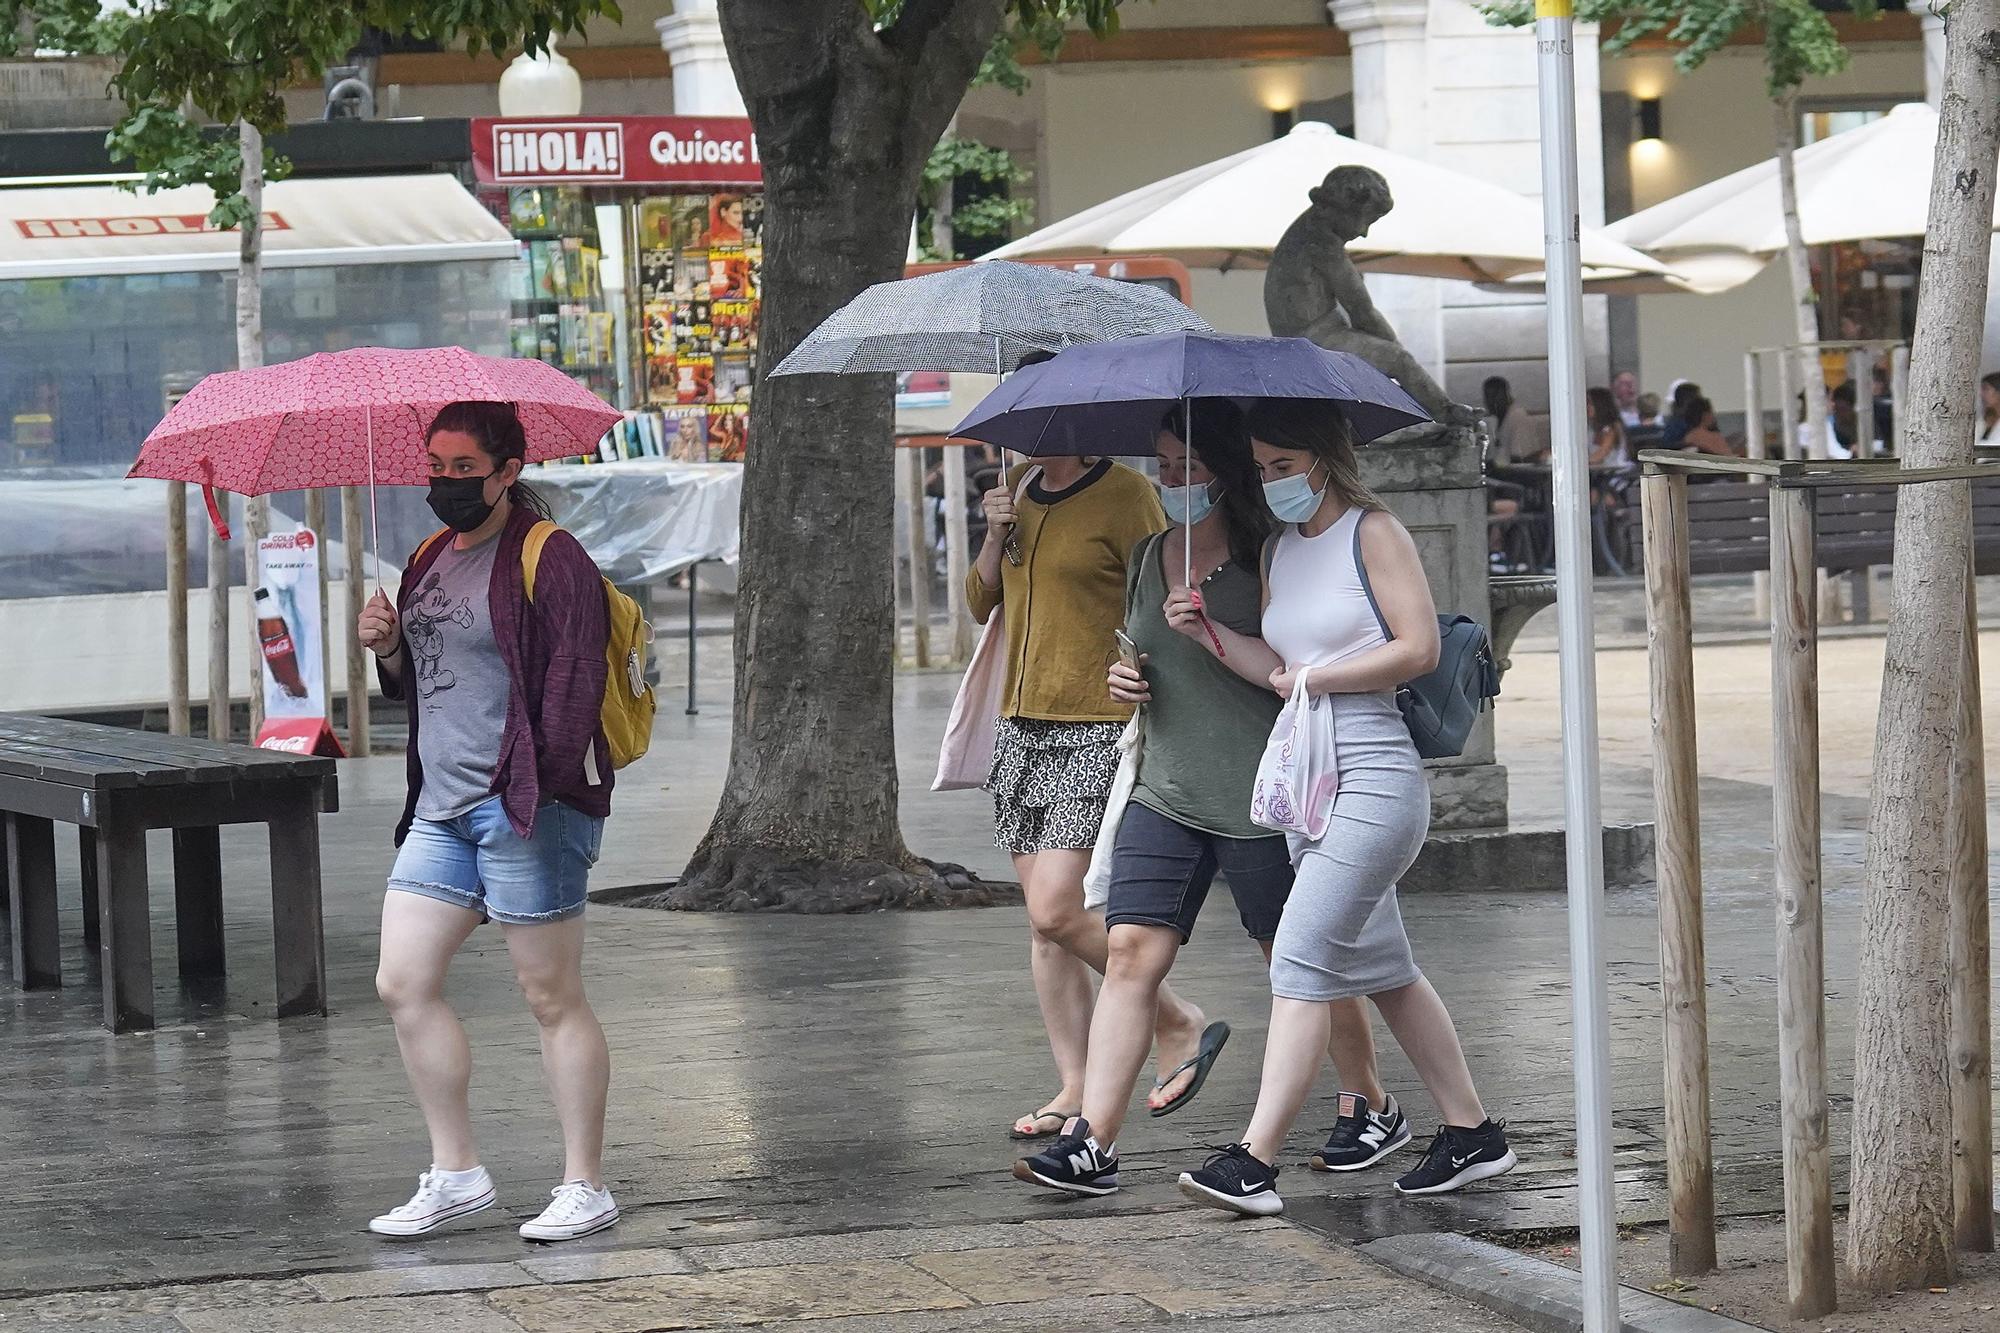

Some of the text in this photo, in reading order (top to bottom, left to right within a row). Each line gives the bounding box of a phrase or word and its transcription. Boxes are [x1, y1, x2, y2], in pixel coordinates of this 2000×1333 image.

[500, 130, 618, 173] ¡HOLA!
[650, 129, 744, 163] Quiosc
[260, 542, 294, 550] DRINKS
